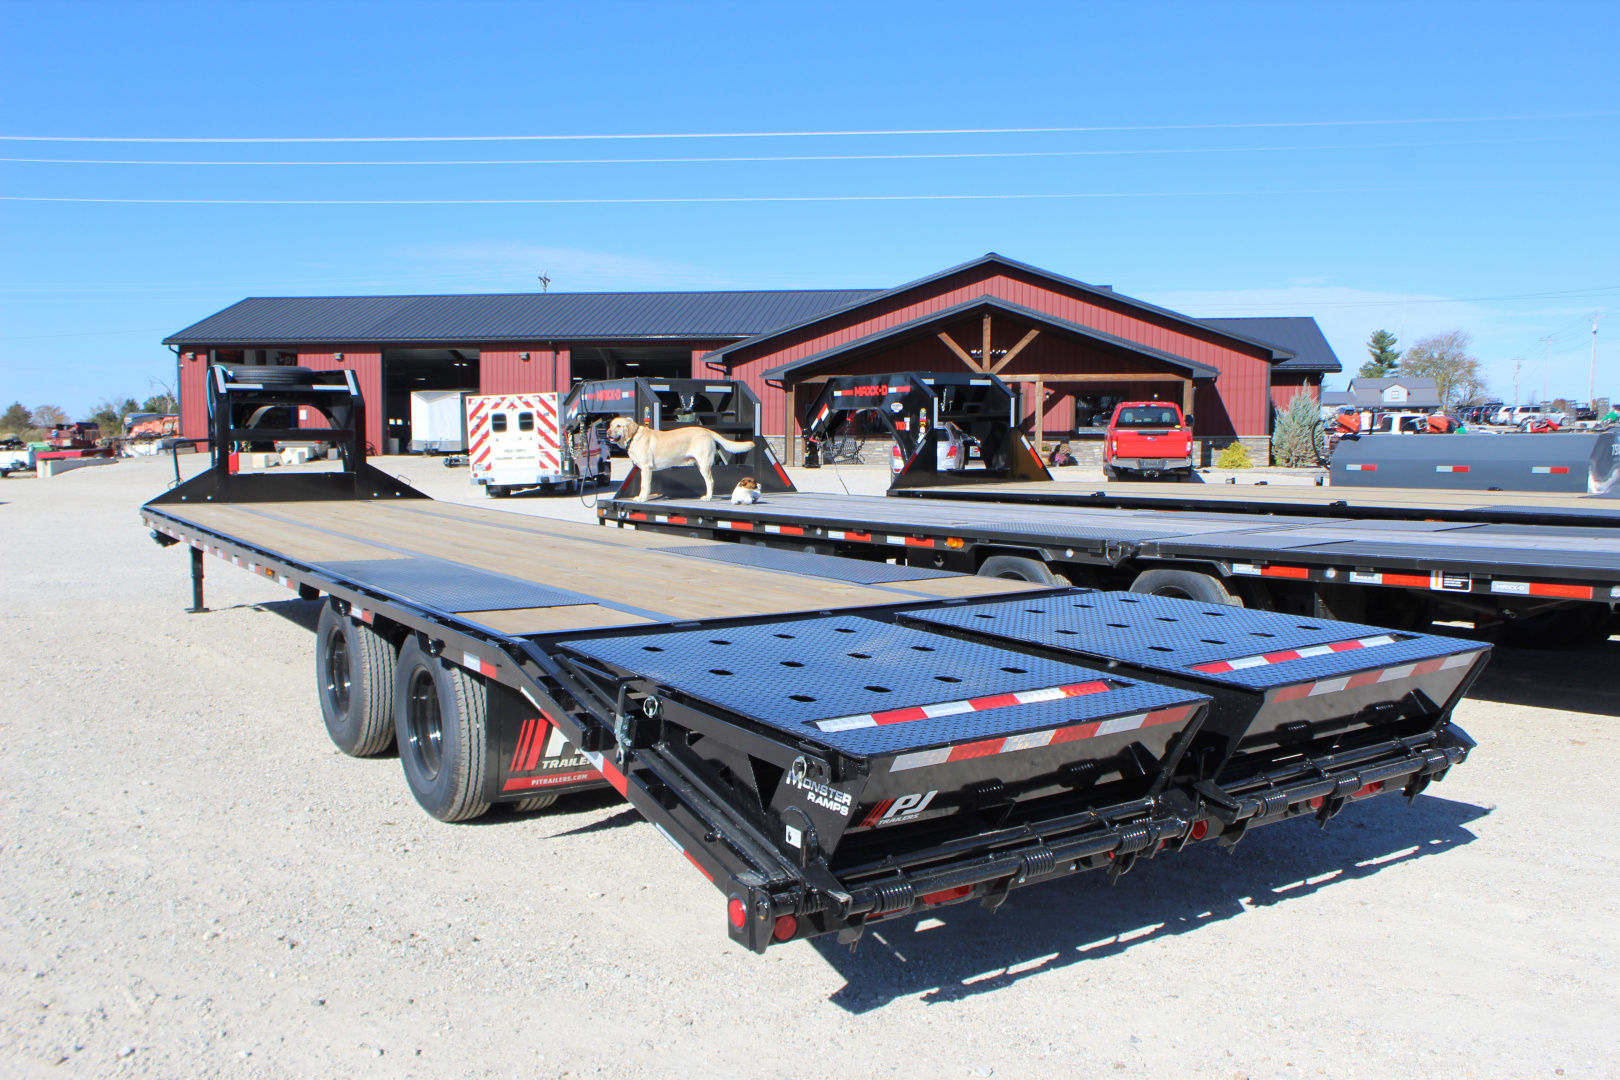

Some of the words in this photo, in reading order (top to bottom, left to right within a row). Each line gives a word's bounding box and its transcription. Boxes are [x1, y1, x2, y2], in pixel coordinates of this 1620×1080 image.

[596, 388, 621, 402] MAXX-D
[854, 385, 888, 396] MAXX-D
[542, 757, 591, 769] TRAILE
[531, 774, 588, 786] PJTRAILERS.COM
[785, 770, 852, 806] MONSTER
[806, 792, 849, 817] RAMPS
[882, 790, 939, 819] PJ
[878, 813, 920, 825] TRAILERS
